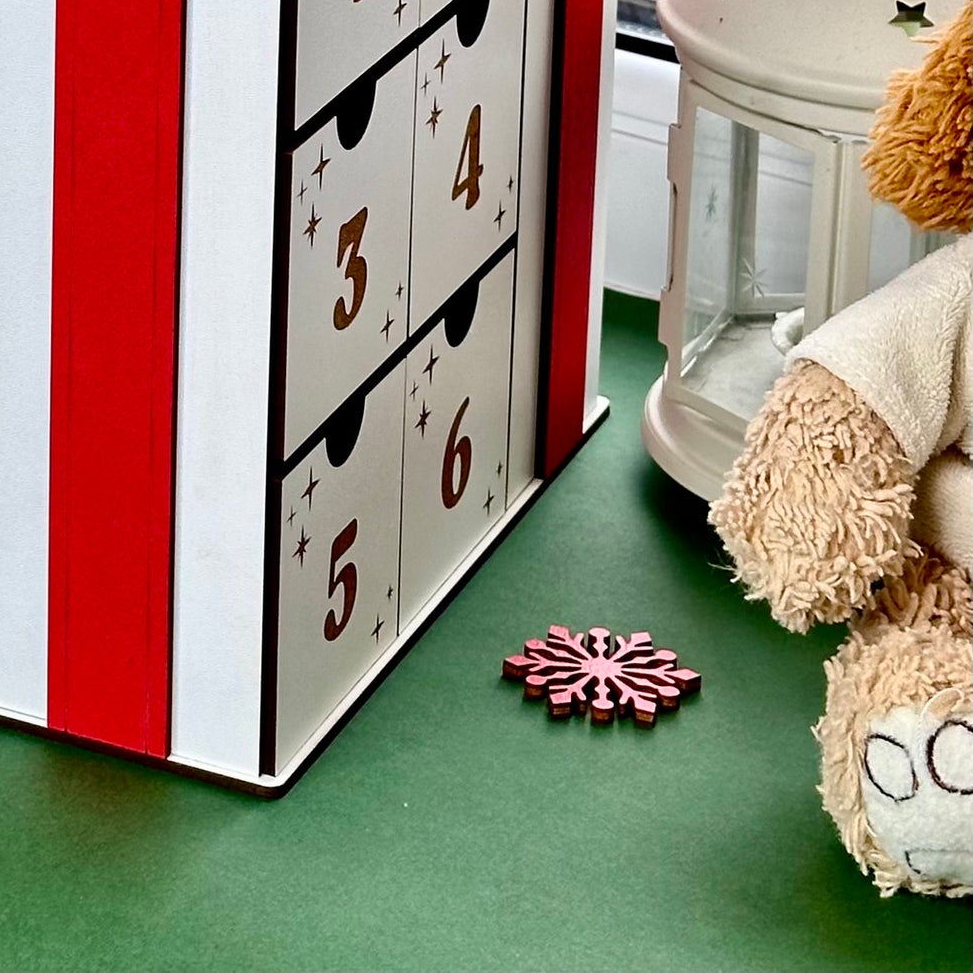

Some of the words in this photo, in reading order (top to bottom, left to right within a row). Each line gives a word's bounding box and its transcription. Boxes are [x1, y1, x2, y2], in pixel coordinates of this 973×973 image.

[452, 104, 484, 210] 4
[333, 207, 368, 330] 3
[441, 397, 472, 509] 6
[324, 519, 358, 641] 5
